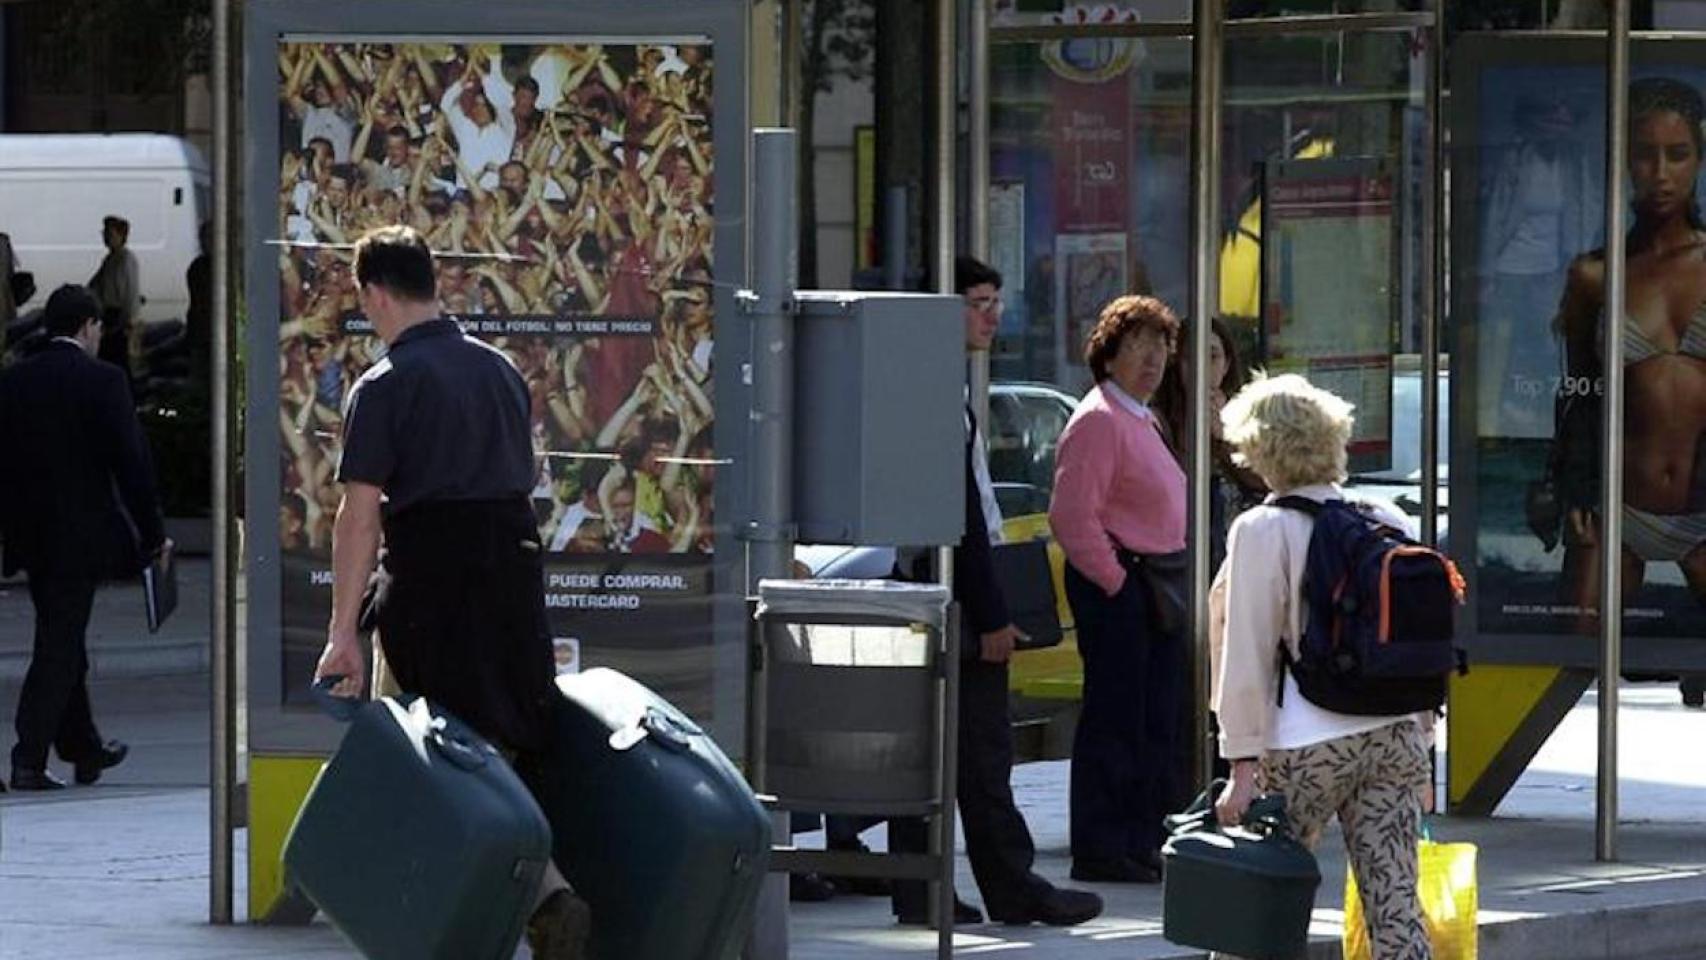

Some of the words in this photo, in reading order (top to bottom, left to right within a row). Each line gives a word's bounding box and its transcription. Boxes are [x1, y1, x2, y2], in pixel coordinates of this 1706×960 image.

[481, 319, 503, 332] DEL
[556, 320, 573, 332] NO
[576, 320, 608, 332] TIENE
[611, 320, 652, 333] PRECIO
[1510, 374, 1543, 399] Top
[550, 574, 600, 588] PUEDE
[604, 574, 688, 589] COMPRAR.
